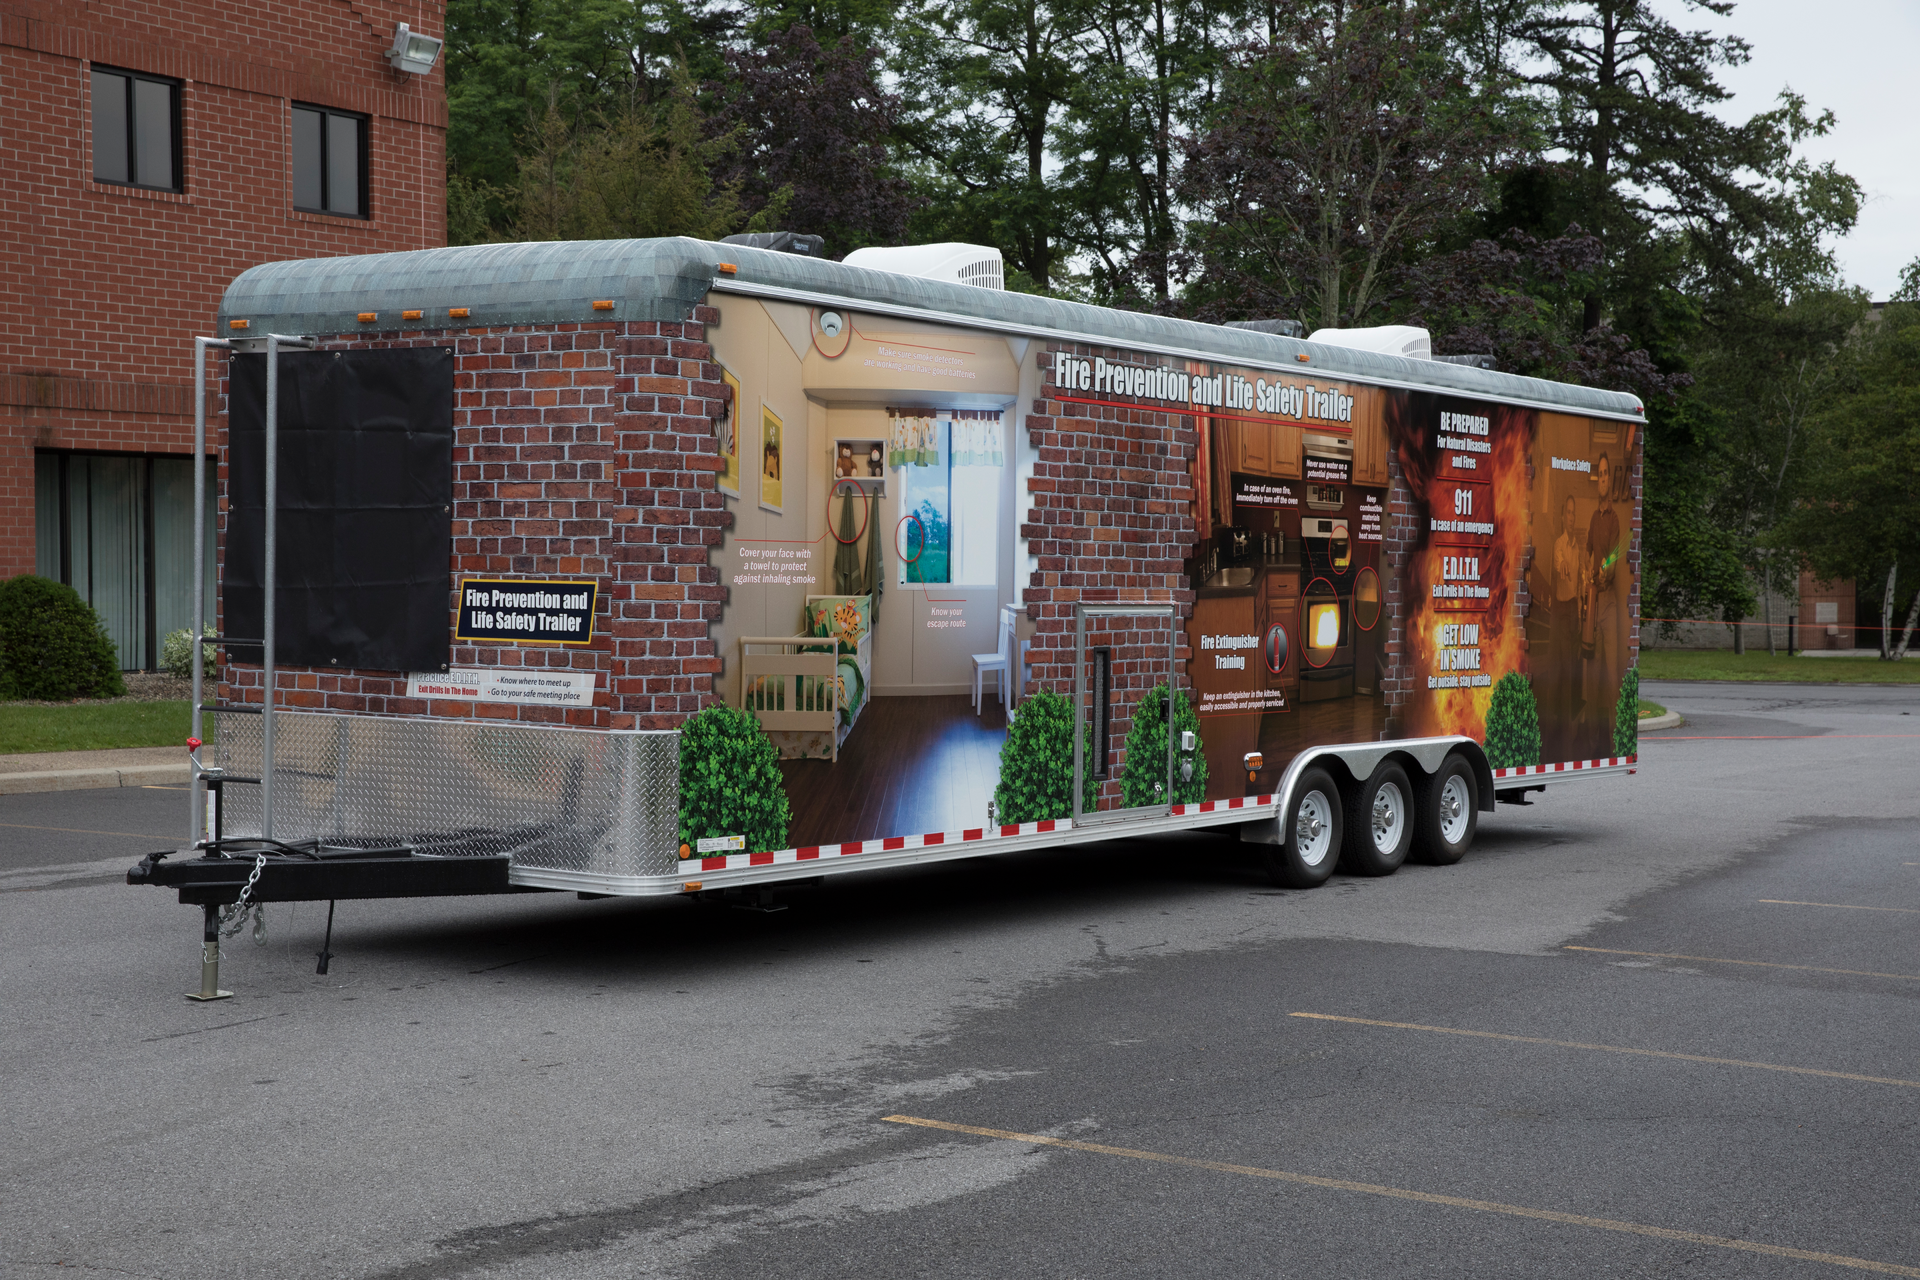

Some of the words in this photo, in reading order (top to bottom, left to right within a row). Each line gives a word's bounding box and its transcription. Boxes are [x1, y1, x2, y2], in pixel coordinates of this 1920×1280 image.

[878, 347, 896, 357] Make
[898, 351, 911, 359] sure
[913, 352, 933, 362] smoke
[935, 355, 963, 366] detectors
[864, 359, 874, 367] are
[877, 359, 901, 372] working
[903, 363, 915, 372] and
[917, 364, 931, 374] have
[932, 368, 947, 377] good
[948, 368, 975, 379] batteries
[1055, 351, 1091, 391] Fire
[1094, 356, 1189, 403] Prevention
[1192, 373, 1223, 407] and
[1225, 374, 1254, 411] Life
[1256, 378, 1304, 420] Safety
[1306, 385, 1353, 422] Trailer
[1441, 411, 1450, 431] BE
[1452, 413, 1489, 436] PREPARED
[1437, 435, 1446, 448] For
[1446, 436, 1466, 450] Natural
[1467, 438, 1491, 454] Disasters
[1306, 459, 1318, 468] Never
[1452, 455, 1462, 468] and
[1463, 455, 1476, 469] Fires
[1552, 456, 1576, 471] Workplace
[1577, 459, 1591, 473] Safety
[1307, 470, 1326, 478] potential
[1326, 471, 1339, 480] grease
[1283, 486, 1291, 496] fire,
[1264, 495, 1273, 503] turn
[1366, 495, 1376, 504] Keep
[1454, 488, 1472, 515] 911
[1360, 504, 1382, 512] combustible
[1437, 520, 1450, 531] case
[1451, 519, 1457, 532] of
[1457, 521, 1464, 532] an
[1465, 521, 1494, 535] emergency
[739, 547, 760, 557] Cover
[761, 550, 777, 559] your
[779, 548, 794, 558] face
[796, 549, 811, 558] with
[744, 562, 748, 570] a
[750, 561, 770, 570] towel
[772, 562, 779, 571] to
[780, 562, 807, 572] protect
[1443, 556, 1480, 580] E.D.I.T.H.
[734, 573, 761, 585] against
[762, 573, 791, 585] inhaling
[792, 575, 816, 584] smoke
[1432, 584, 1442, 597] Exit
[1443, 584, 1458, 598] Drills
[1458, 585, 1464, 598] In
[1464, 585, 1474, 598] The
[1474, 585, 1490, 598] Home
[466, 589, 489, 607] Fire
[492, 590, 560, 609] Prevention
[563, 592, 588, 609] and
[931, 607, 948, 616] Know
[949, 608, 963, 618] your
[471, 611, 494, 629] Life
[496, 612, 536, 632] Safety
[538, 613, 581, 632] Trailer
[927, 620, 949, 629] escape
[950, 619, 966, 628] route
[1444, 624, 1459, 645] GET
[1460, 624, 1479, 645] LOW
[1201, 635, 1214, 650] Fire
[1216, 634, 1259, 651] Extinguisher
[1215, 654, 1245, 670] Training
[1441, 649, 1450, 670] IN
[1451, 649, 1480, 670] SMOKE
[417, 672, 449, 683] Practice
[450, 671, 480, 685] E.D.I.T.H.
[500, 677, 517, 685] Know
[563, 680, 571, 688] up
[1428, 675, 1437, 688] Get
[1460, 675, 1471, 687] stay
[1472, 673, 1491, 686] outside
[419, 685, 428, 693] Exit
[429, 686, 443, 694] Drills
[444, 686, 450, 694] In
[451, 687, 461, 695] The
[462, 688, 478, 696] Home
[491, 688, 500, 696] Go
[508, 690, 522, 698] your
[537, 691, 562, 700] meeting
[563, 692, 580, 700] place
[1203, 693, 1215, 702] Keep
[1223, 691, 1250, 700] extinguisher
[1251, 690, 1255, 698] in
[1200, 703, 1213, 712] easily
[1214, 702, 1238, 710] accessible
[1248, 700, 1265, 710] properly
[1266, 699, 1284, 707] serviced
